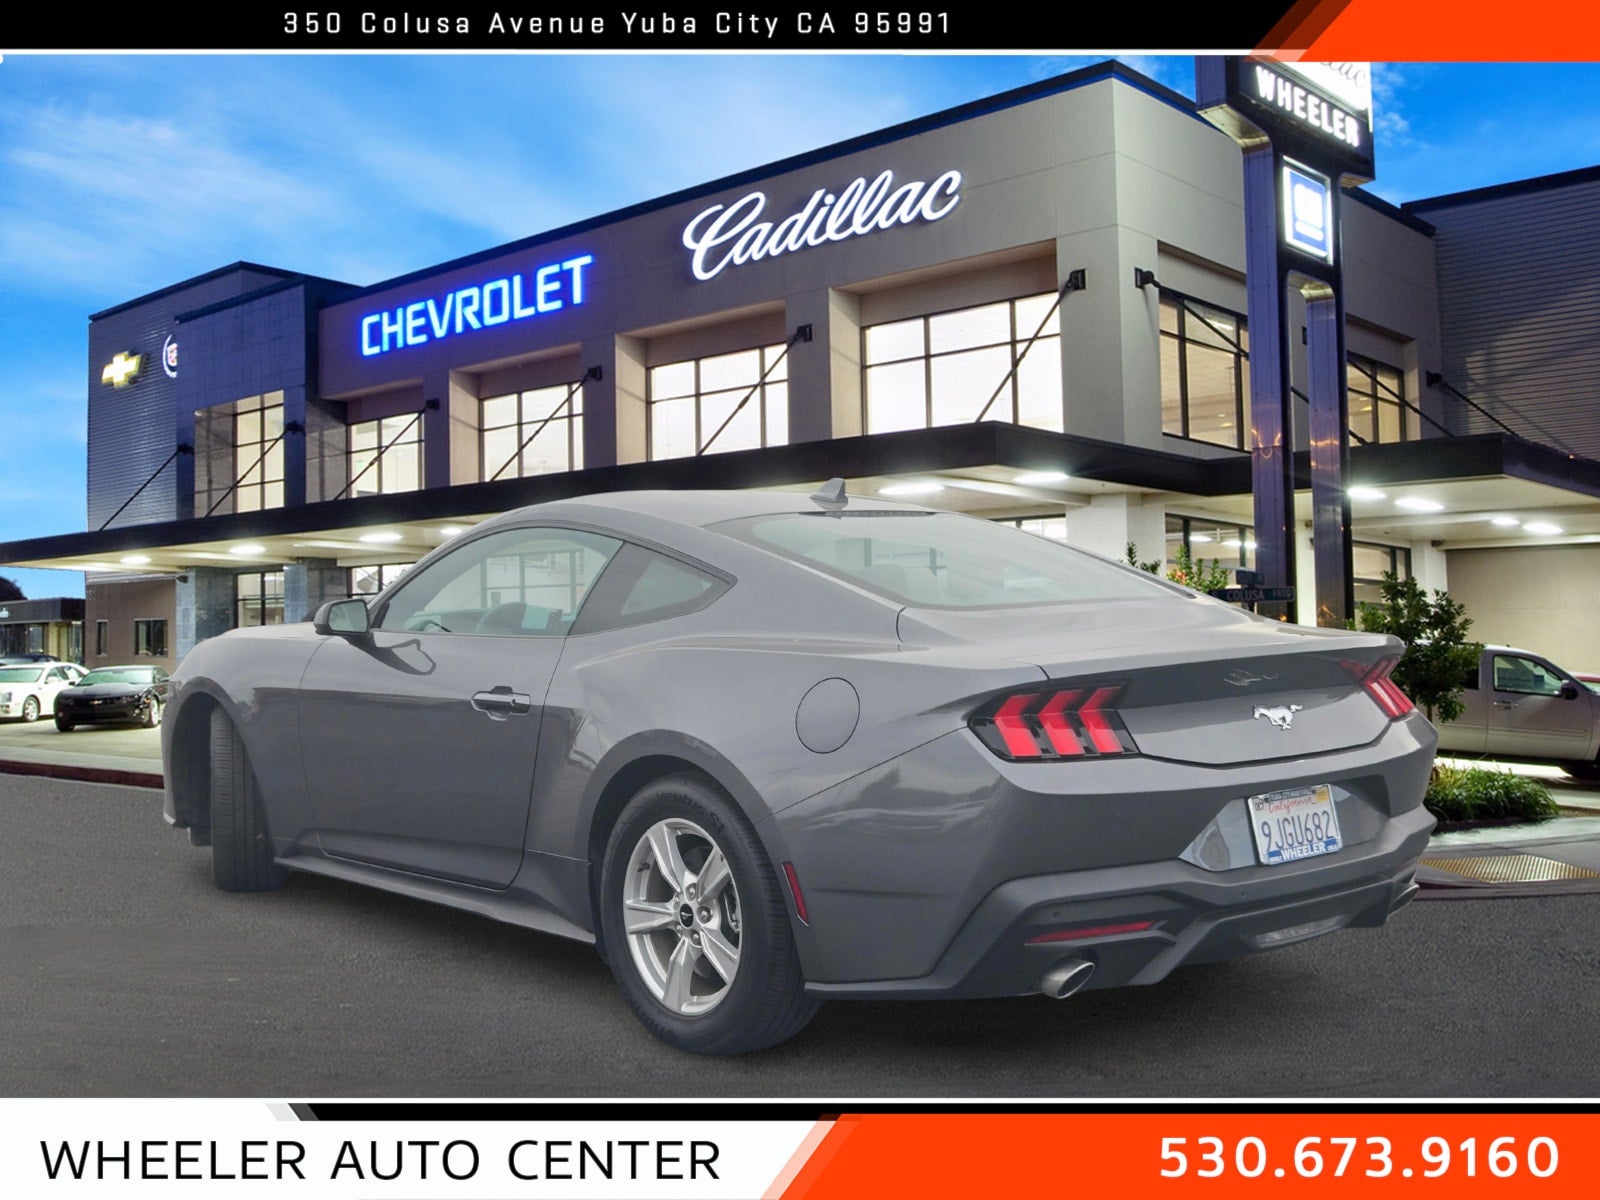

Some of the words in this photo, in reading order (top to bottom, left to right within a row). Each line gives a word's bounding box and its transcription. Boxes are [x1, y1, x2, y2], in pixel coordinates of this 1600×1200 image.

[1255, 64, 1360, 148] WHEELER
[682, 169, 962, 281] Cadillac
[361, 254, 593, 357] CHEVROLET
[1226, 588, 1265, 600] COLUSA
[1267, 797, 1317, 814] California
[1261, 810, 1334, 853] 9JGU682
[1280, 842, 1327, 861] WHEELER
